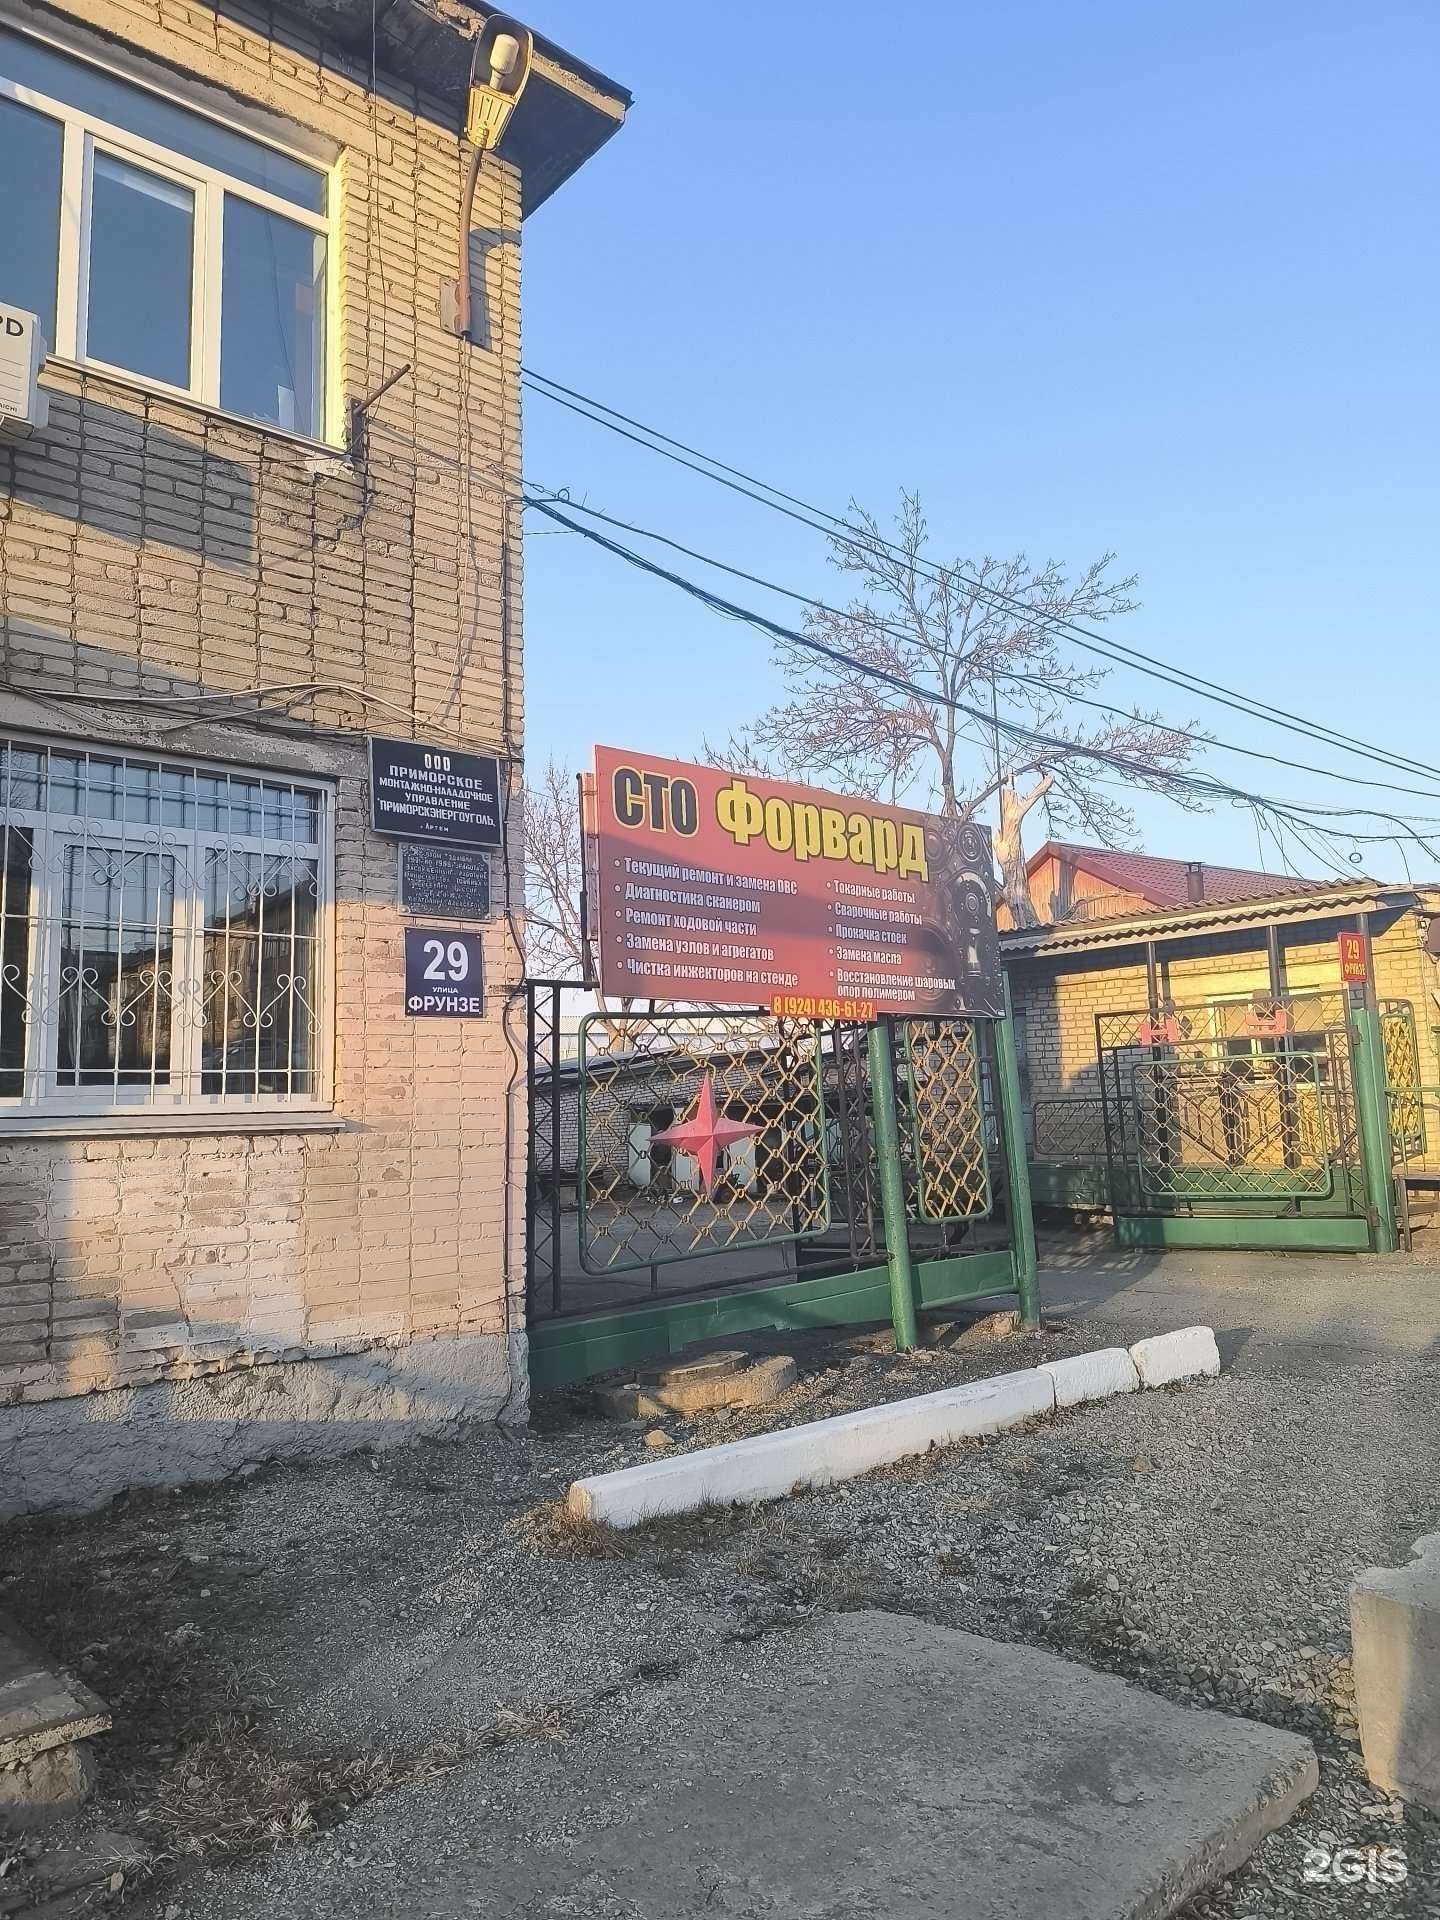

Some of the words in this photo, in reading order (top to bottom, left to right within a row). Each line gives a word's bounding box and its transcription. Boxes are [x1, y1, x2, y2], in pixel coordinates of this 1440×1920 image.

[425, 754, 450, 771] ООО
[390, 765, 483, 790] ПРИМОРСКОЕ
[379, 777, 494, 802] МОНТАЖНО-НАЛАДОЧНОЕ
[405, 792, 470, 810] УПРАВЛЕНИЕ
[612, 765, 699, 838] СТО
[715, 777, 929, 883] Форвард
[624, 857, 679, 878] Текущий
[681, 869, 724, 885] ремонт
[726, 875, 734, 886] и
[735, 875, 776, 892] замена
[625, 883, 703, 907] Диагностика
[705, 894, 761, 913] сканером
[833, 879, 881, 899] Токарные
[882, 886, 916, 904] работы
[625, 908, 671, 927] Ремонт
[673, 915, 723, 933] ходовой
[725, 922, 757, 936] части
[835, 902, 887, 922] Сварочные
[889, 909, 923, 925] работы
[835, 924, 880, 944] Прокачка
[882, 931, 907, 944] стоек
[626, 933, 673, 952] Замена
[675, 939, 709, 956] узлов
[712, 943, 720, 955] и
[721, 943, 775, 961] агрегатов
[836, 946, 872, 962] Замена
[873, 950, 902, 965] масла
[1346, 940, 1359, 959] 29
[423, 939, 469, 982] 29
[627, 958, 671, 976] Чистка
[673, 964, 744, 984] инжекторов
[746, 970, 759, 983] на
[761, 970, 798, 988] стенде
[837, 968, 914, 987] Восстановление
[915, 974, 956, 990] шаровых
[432, 986, 458, 994] УЛИЦА
[837, 986, 860, 998] опор
[861, 986, 915, 1002] полимером
[408, 996, 480, 1013] ФРУНЗЕ
[773, 996, 781, 1014] 8
[784, 997, 816, 1015] (924)
[818, 999, 873, 1018] 436-61-27
